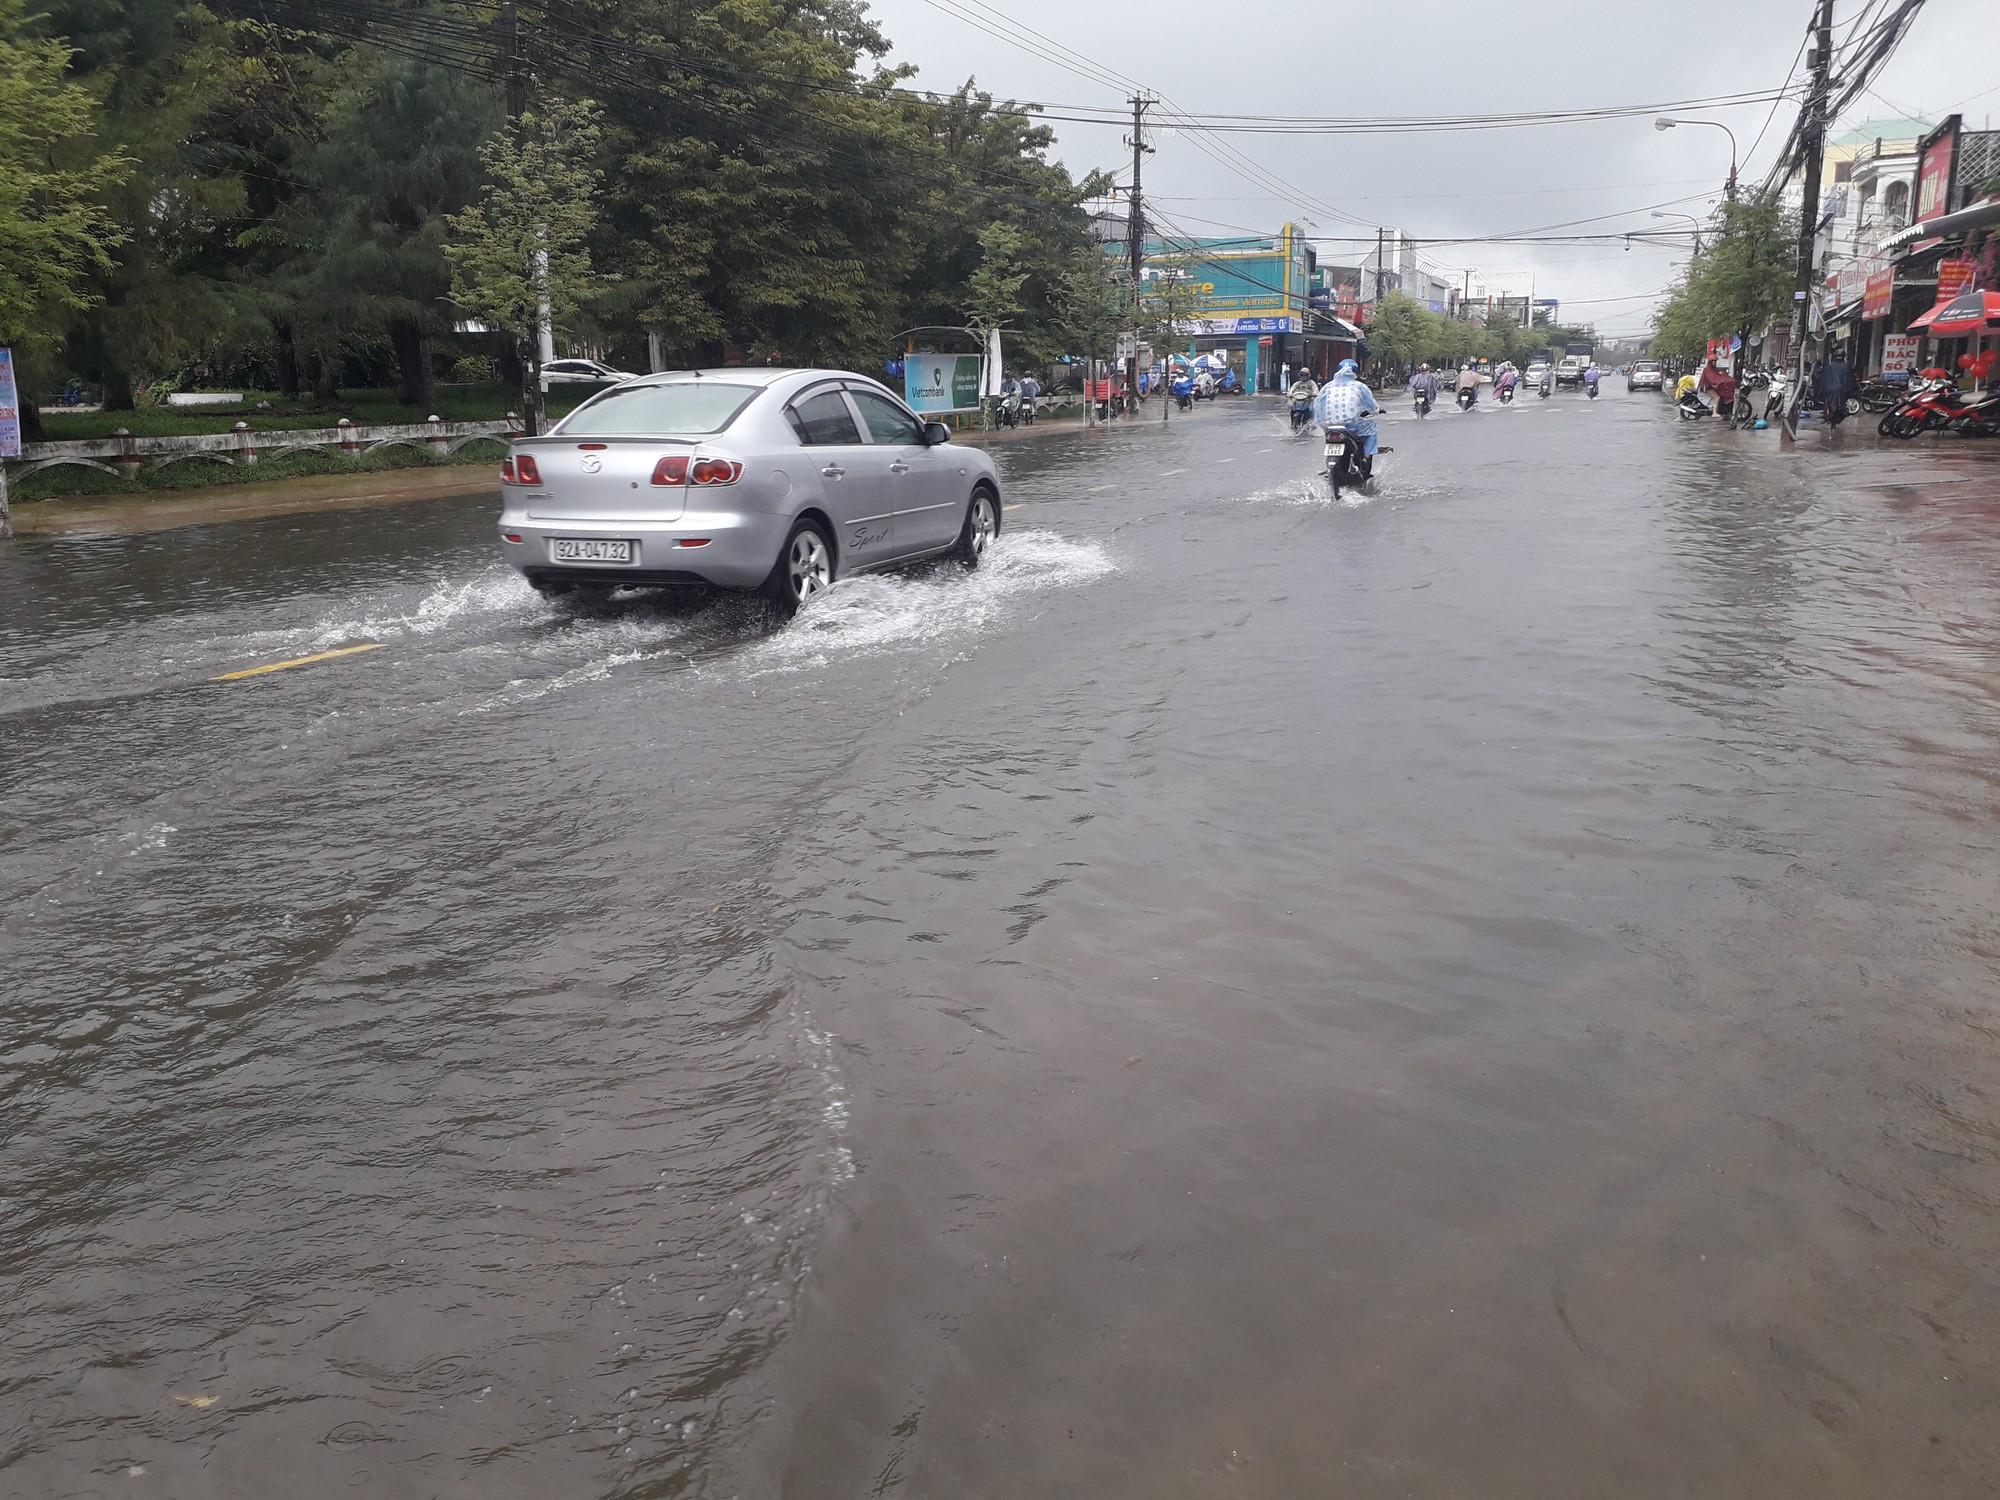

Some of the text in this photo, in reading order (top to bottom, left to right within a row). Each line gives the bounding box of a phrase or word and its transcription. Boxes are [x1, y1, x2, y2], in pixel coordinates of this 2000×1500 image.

[1885, 360, 1903, 371] SỐ
[911, 386, 946, 398] Vietcombank
[849, 527, 889, 551] Sport
[558, 542, 627, 560] 92A-047.32
